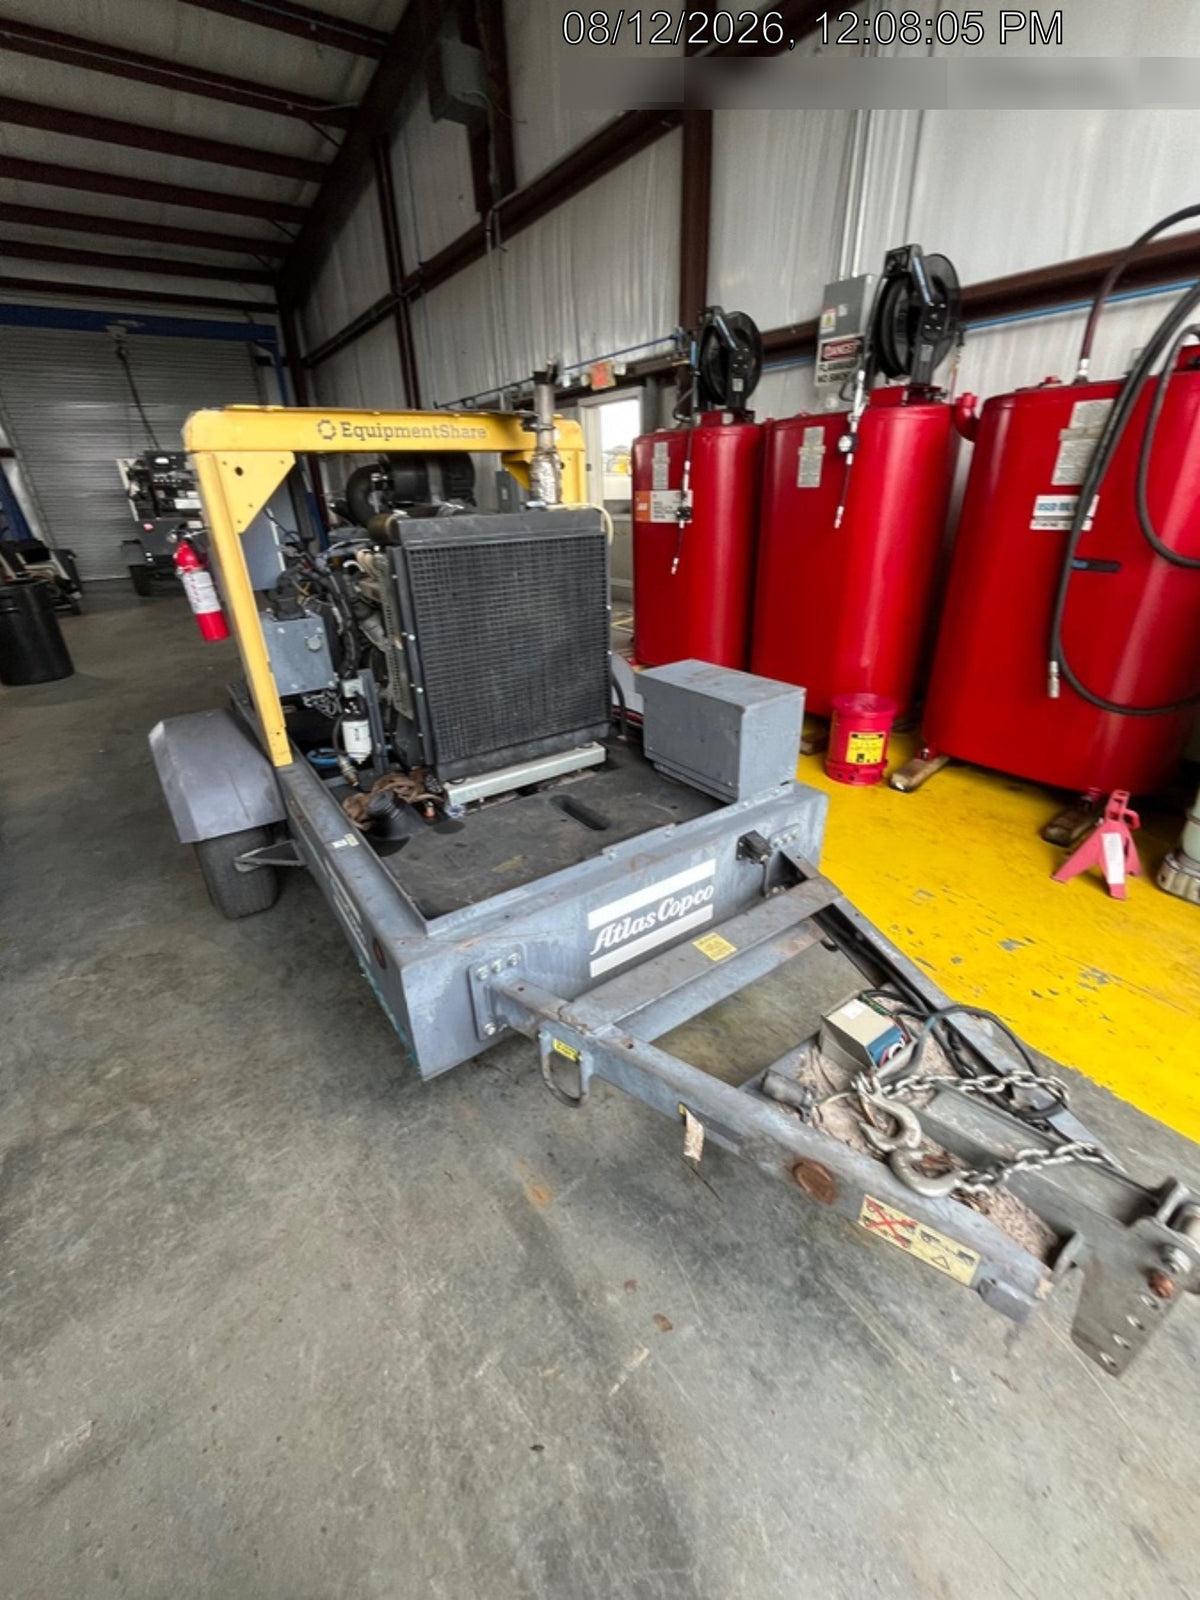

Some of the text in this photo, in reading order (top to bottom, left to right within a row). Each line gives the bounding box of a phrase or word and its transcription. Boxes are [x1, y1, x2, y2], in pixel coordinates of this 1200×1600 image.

[340, 421, 488, 441] EquipmentShare
[589, 911, 656, 956] Atlas
[657, 884, 715, 922] Copco
